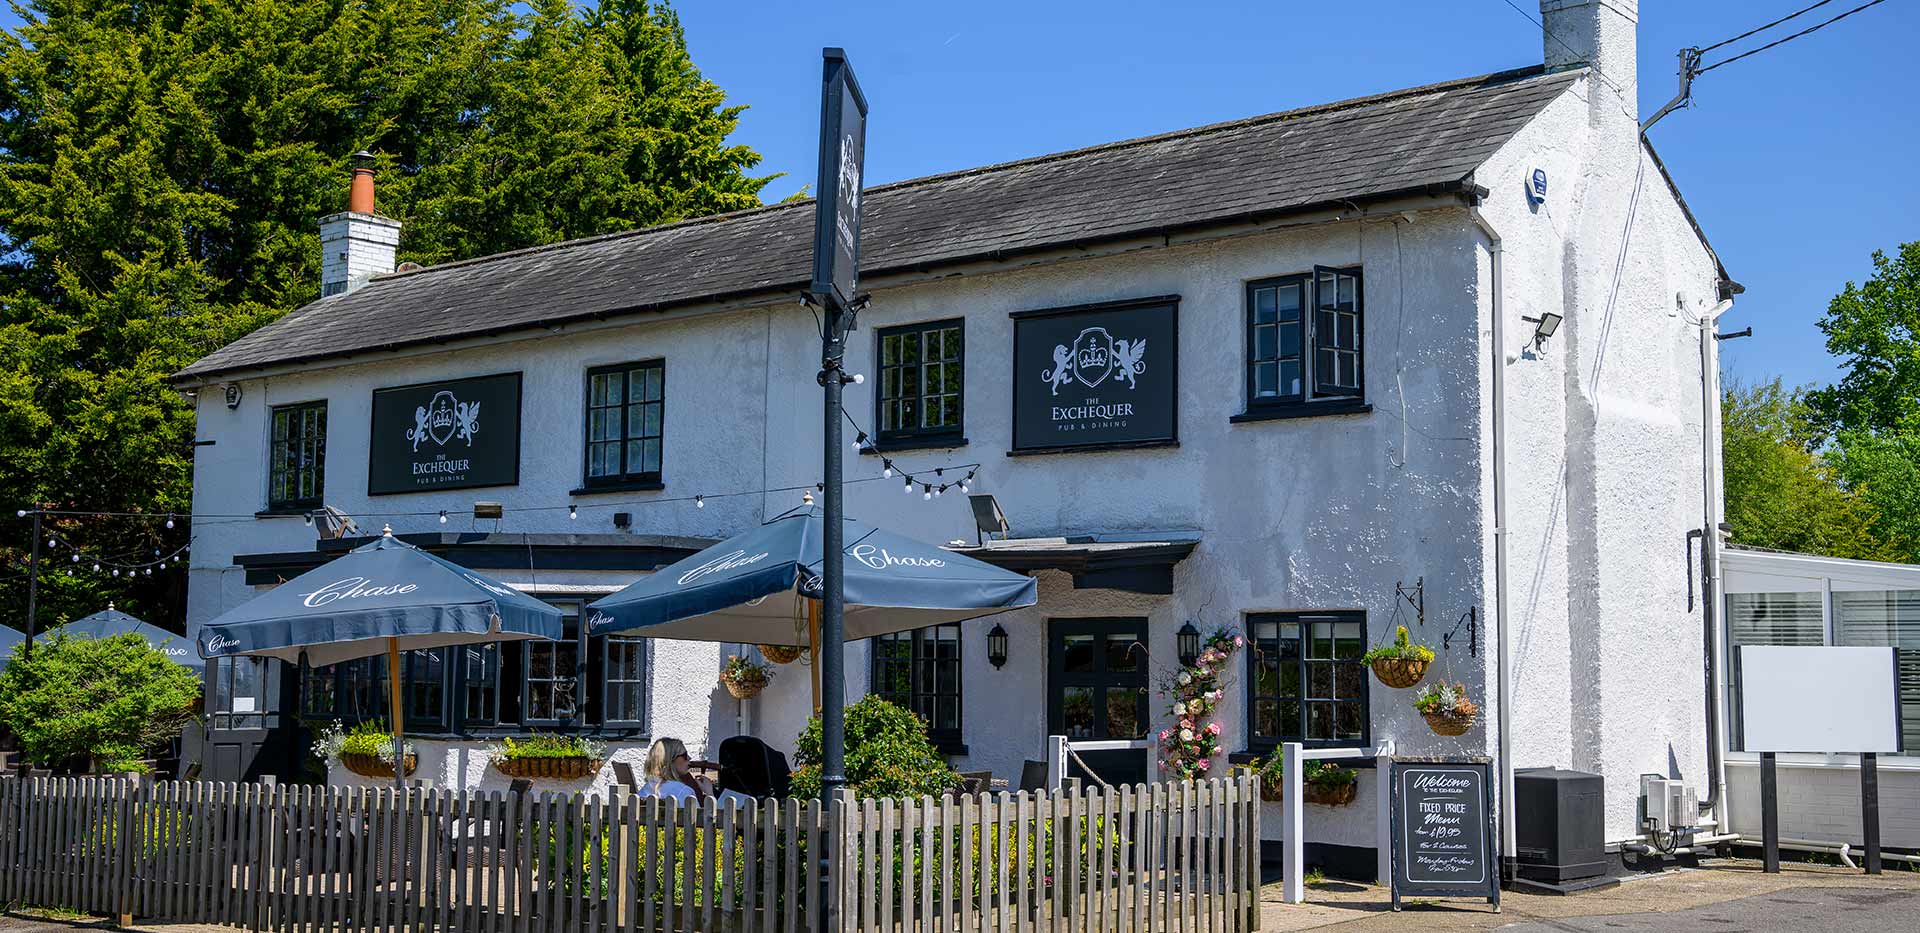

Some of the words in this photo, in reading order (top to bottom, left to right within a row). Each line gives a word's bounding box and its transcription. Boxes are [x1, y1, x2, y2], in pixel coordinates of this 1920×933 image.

[1052, 403, 1134, 420] EXCHEQUER
[1091, 420, 1127, 429] DINING
[413, 459, 470, 474] EXCHEQUER
[848, 544, 946, 569] Chase
[678, 549, 769, 584] Chase
[298, 576, 419, 607] Chase
[590, 610, 615, 630] Chase
[208, 634, 241, 652] Chase
[1413, 773, 1471, 788] Welcome
[1419, 803, 1440, 813] FIXED
[1445, 803, 1466, 813] PRICE
[1424, 813, 1461, 824] Menu
